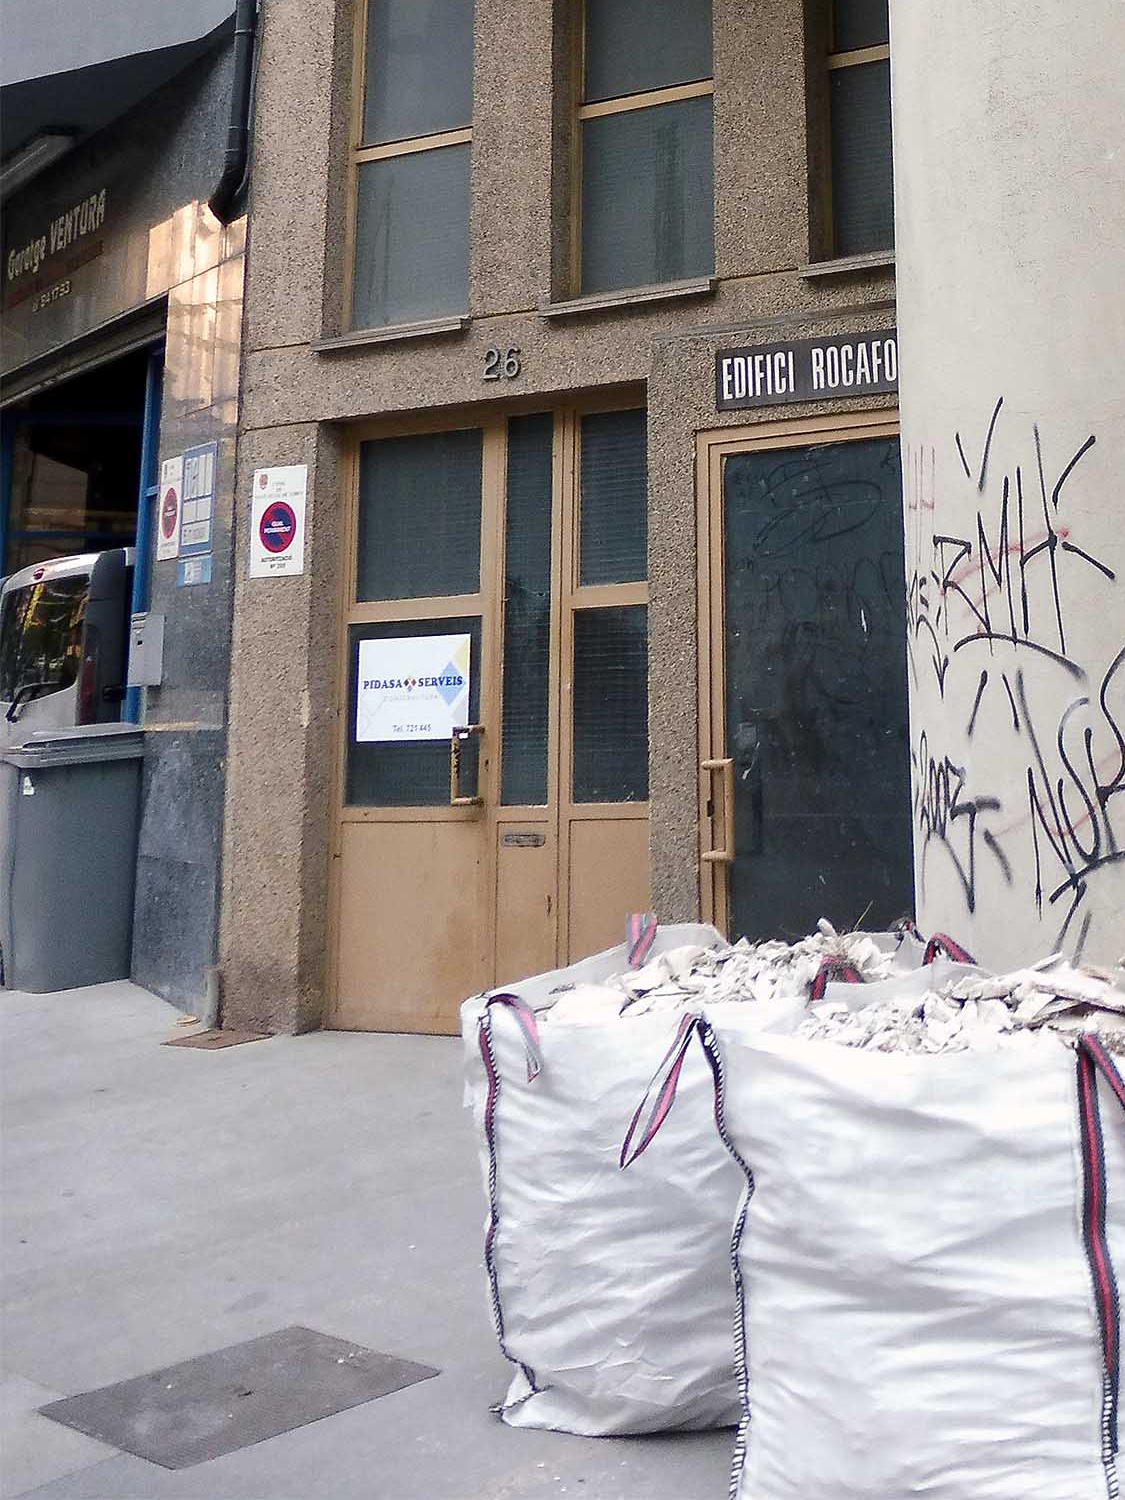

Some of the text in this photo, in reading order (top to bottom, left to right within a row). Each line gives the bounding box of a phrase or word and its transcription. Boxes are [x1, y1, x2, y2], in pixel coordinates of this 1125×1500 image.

[50, 188, 106, 255] VENTURA
[479, 347, 520, 381] 26
[721, 350, 796, 401] EDIFICI
[363, 675, 463, 690] PIDASA SERVEIS
